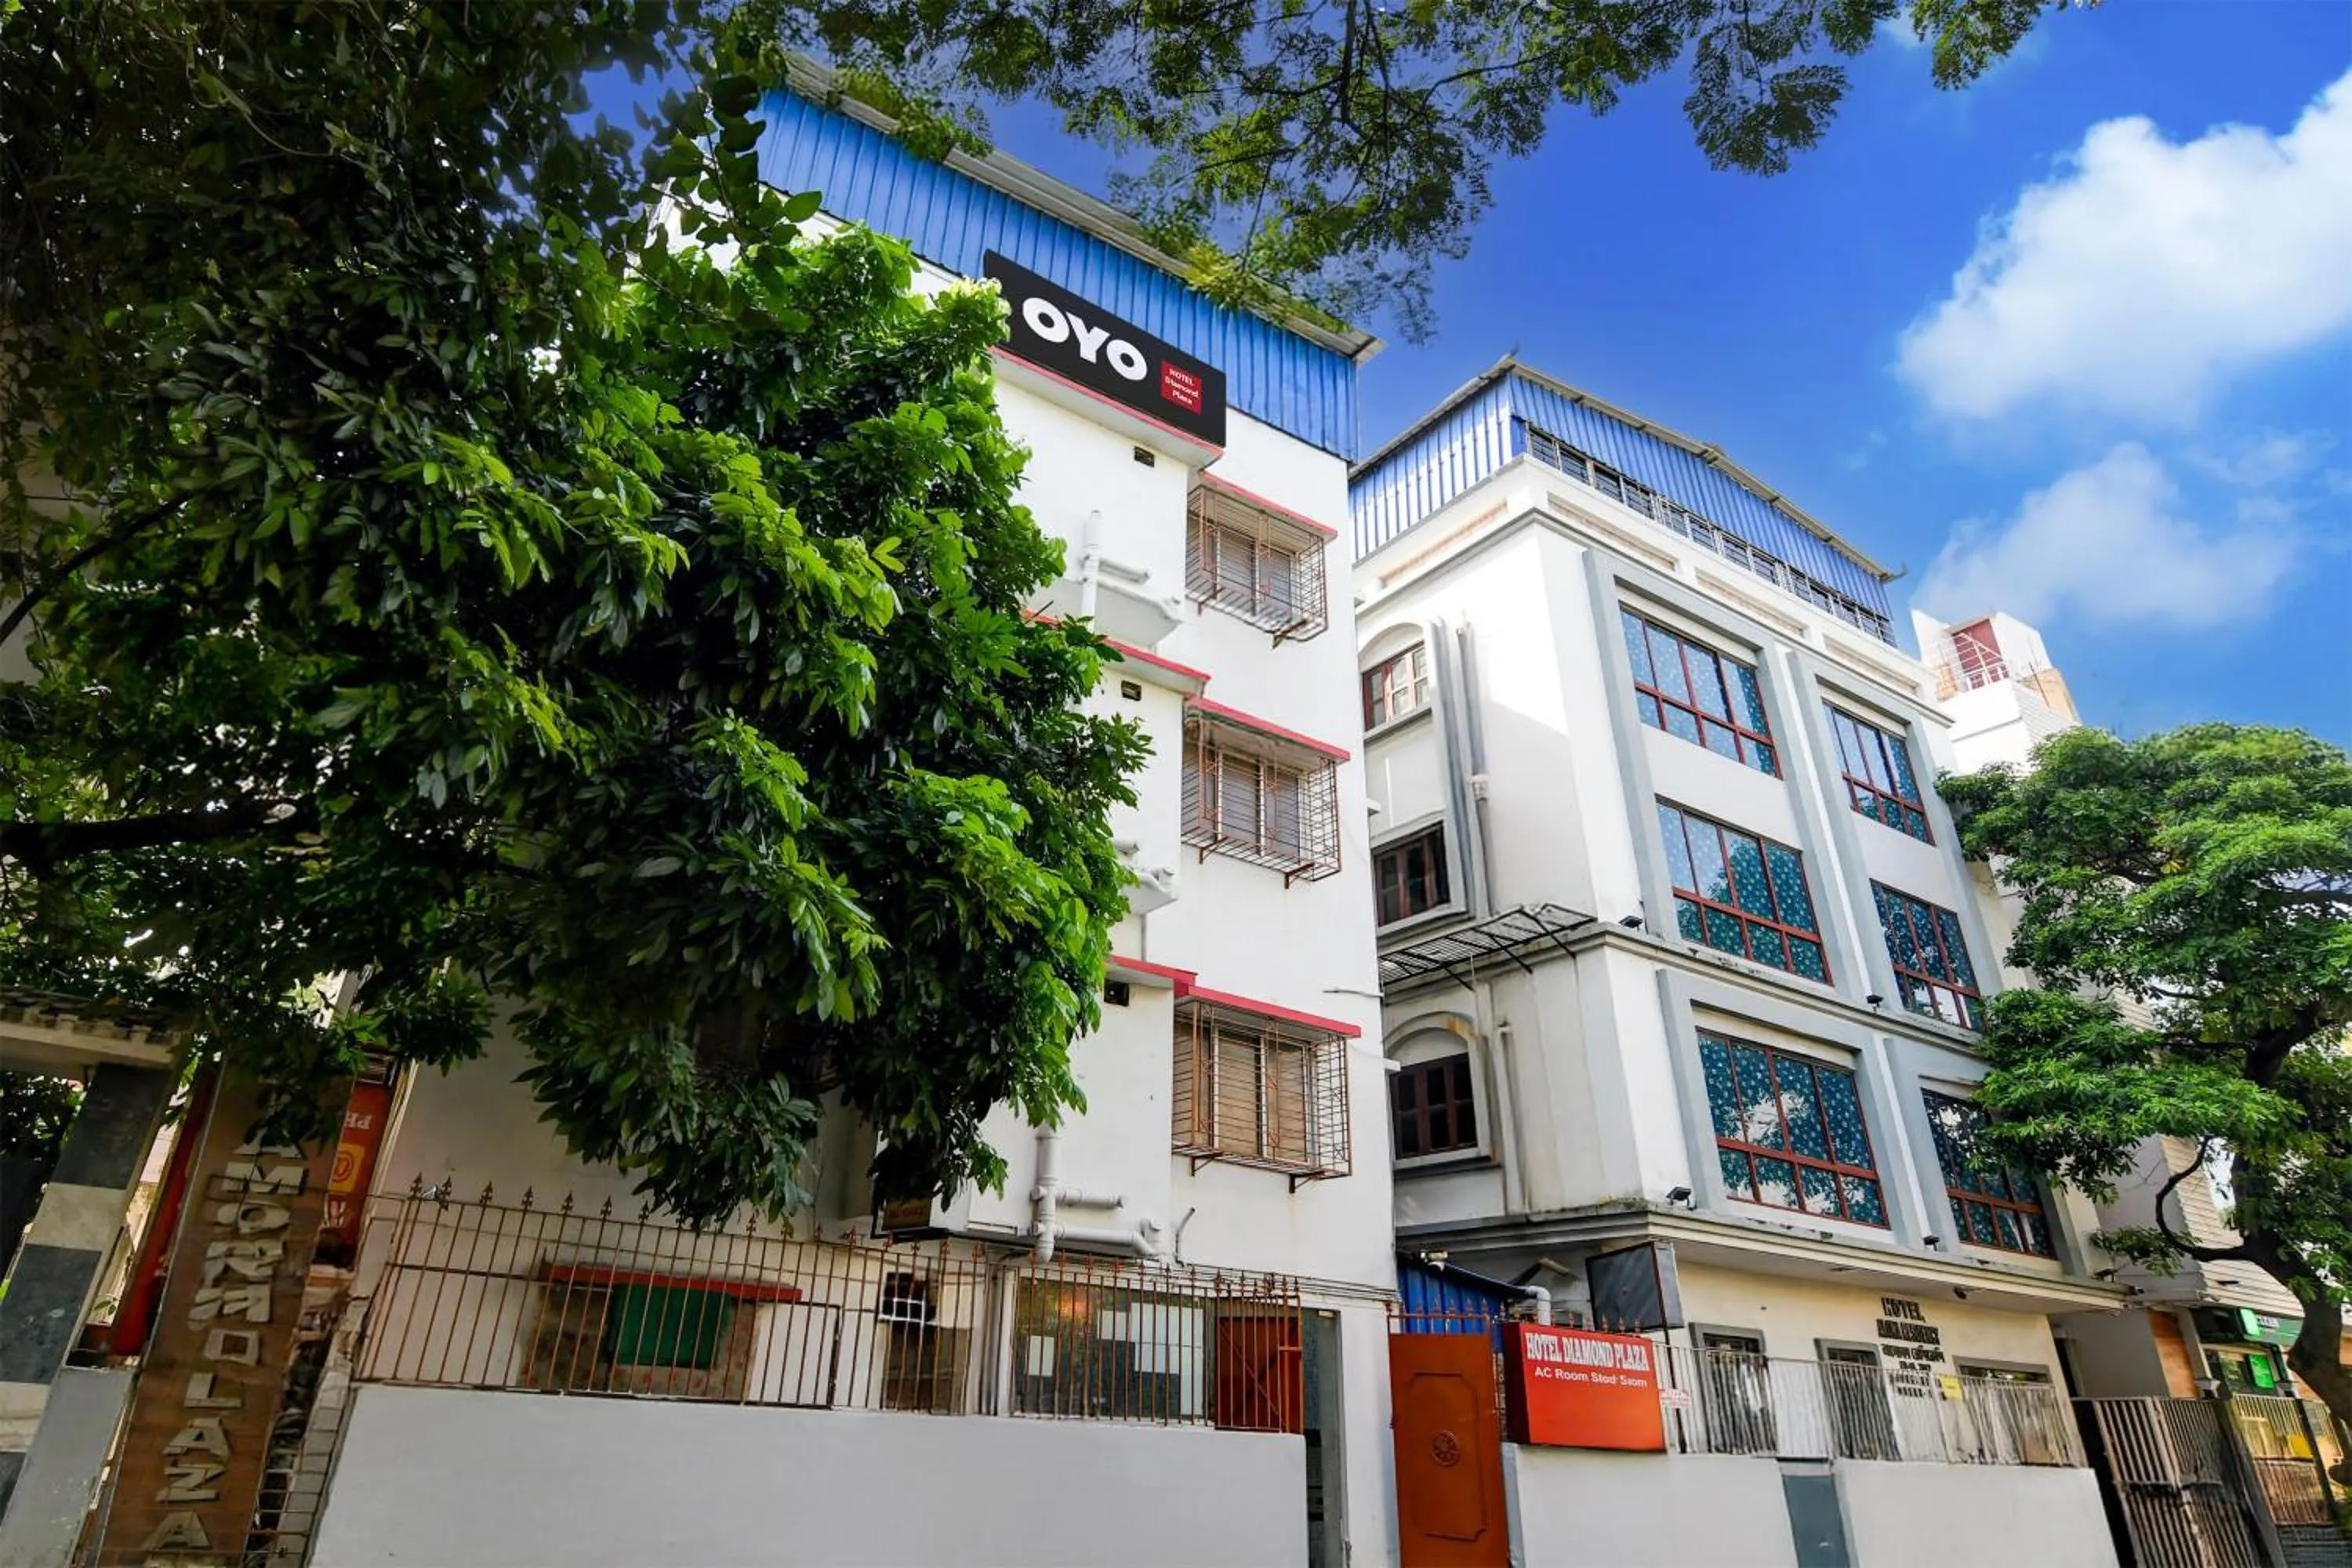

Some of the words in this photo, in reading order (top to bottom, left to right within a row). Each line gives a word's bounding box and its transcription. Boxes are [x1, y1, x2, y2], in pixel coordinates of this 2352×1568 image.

[1022, 297, 1148, 381] OYO
[1881, 1296, 1926, 1323] HOTEL
[1525, 1332, 1563, 1363] HOTEL
[1561, 1336, 1614, 1368] DIAMOND
[1613, 1342, 1650, 1372] PLAZA
[1534, 1366, 1552, 1378] AC
[1555, 1367, 1588, 1382] Room
